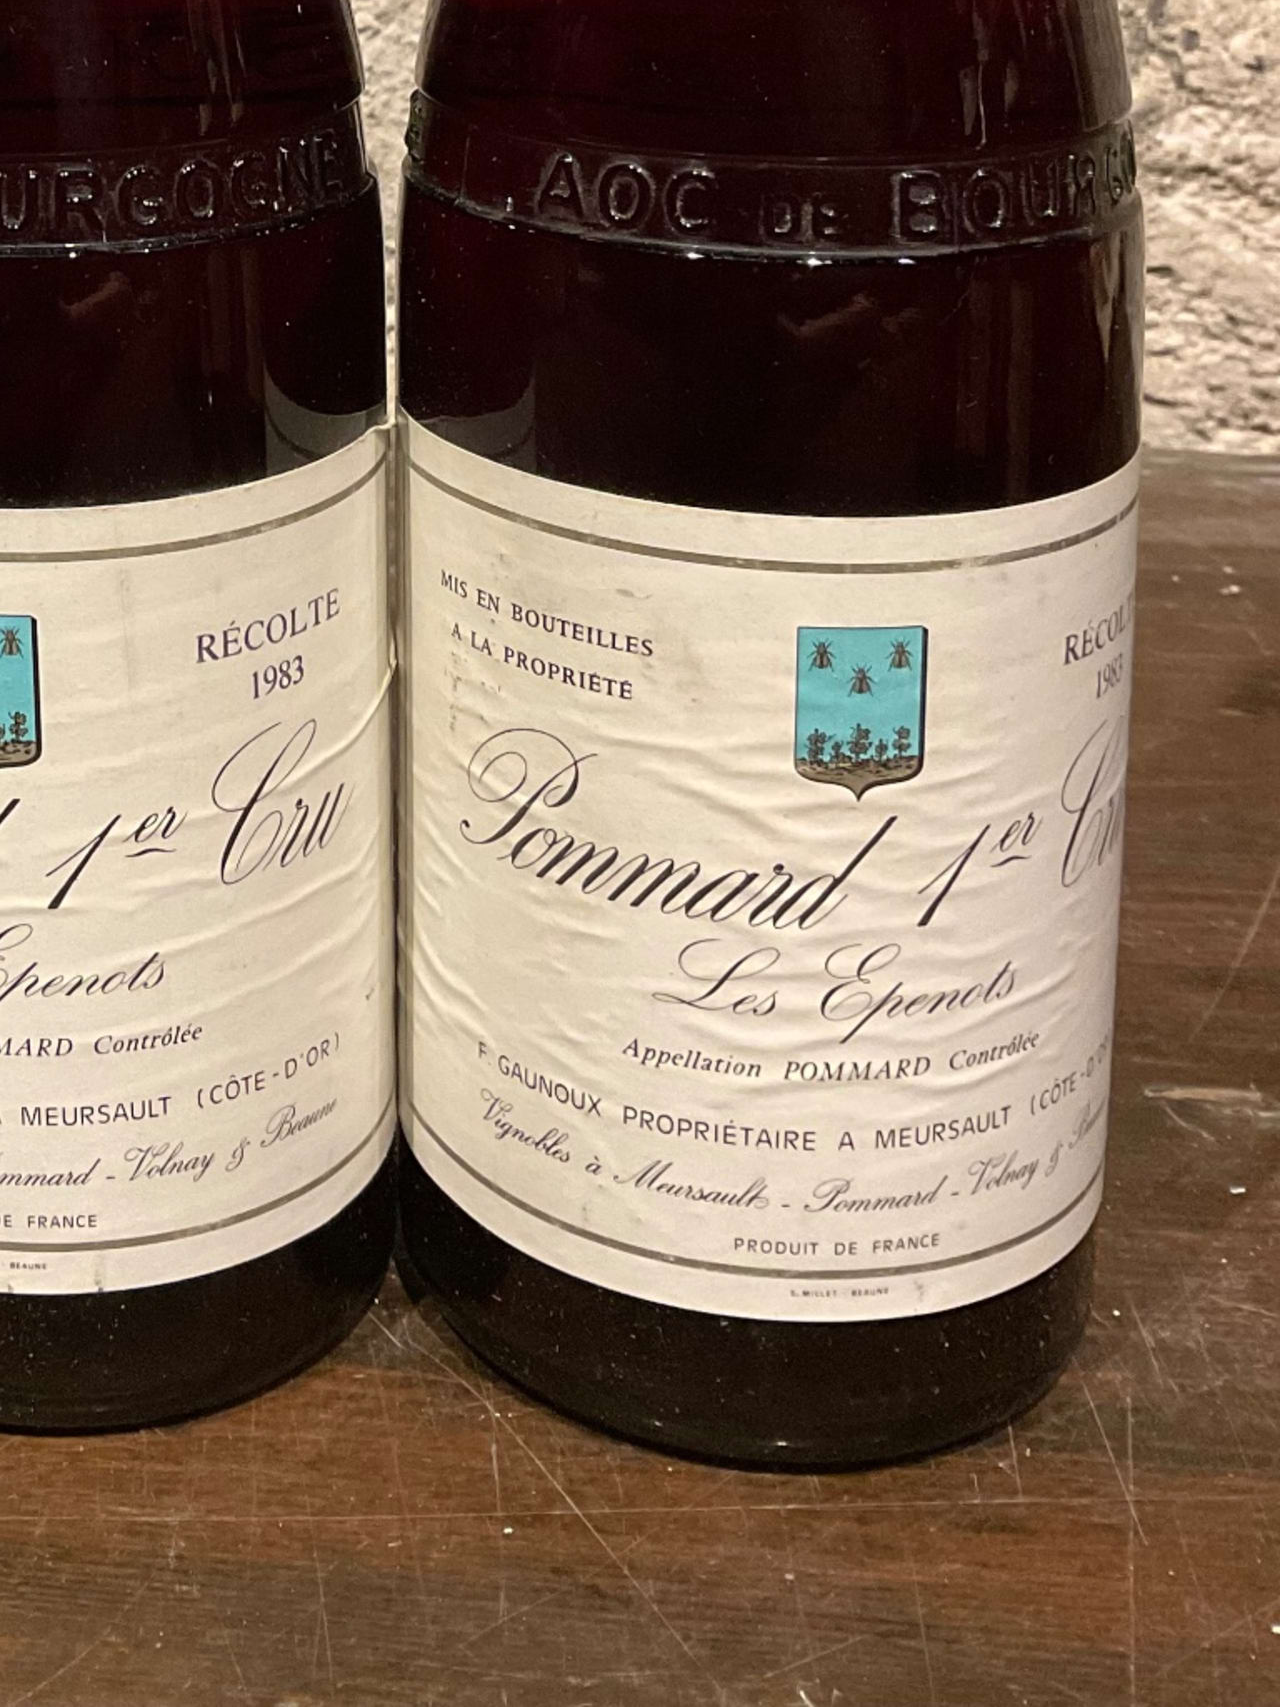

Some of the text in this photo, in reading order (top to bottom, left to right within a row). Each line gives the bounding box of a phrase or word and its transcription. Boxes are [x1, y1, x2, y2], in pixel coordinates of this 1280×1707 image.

[535, 153, 719, 236] AOC
[195, 587, 341, 664] RÉCOLTE
[440, 569, 655, 657] MIS EN BOUTEILLES
[251, 654, 306, 700] 1983
[451, 622, 634, 701] A LA PROPRIÉTÉ
[211, 717, 356, 886] Cru
[459, 727, 898, 930] Pommard
[651, 938, 1016, 1044] Les Epenots
[93, 1023, 203, 1056] Contrôlée
[622, 1030, 1039, 1082] Appellation POMMARD Contrôlée
[20, 1096, 172, 1127] MEURSAULT
[123, 1140, 216, 1183] Volnay
[259, 1097, 338, 1149] Beaune
[498, 1054, 602, 1117] GAUNOUX
[623, 1105, 817, 1151] PROPRIÉTAIRE
[838, 1131, 855, 1151] A
[875, 1104, 1012, 1150] MEURSAULT
[480, 1088, 572, 1164] Vignobles
[613, 1159, 771, 1210] Meursault
[803, 1174, 949, 1213] Pommard
[966, 1150, 1040, 1197] Volnay
[27, 1214, 98, 1229] FRANCE
[733, 1232, 941, 1256] PRODUIT DE FRANCE
